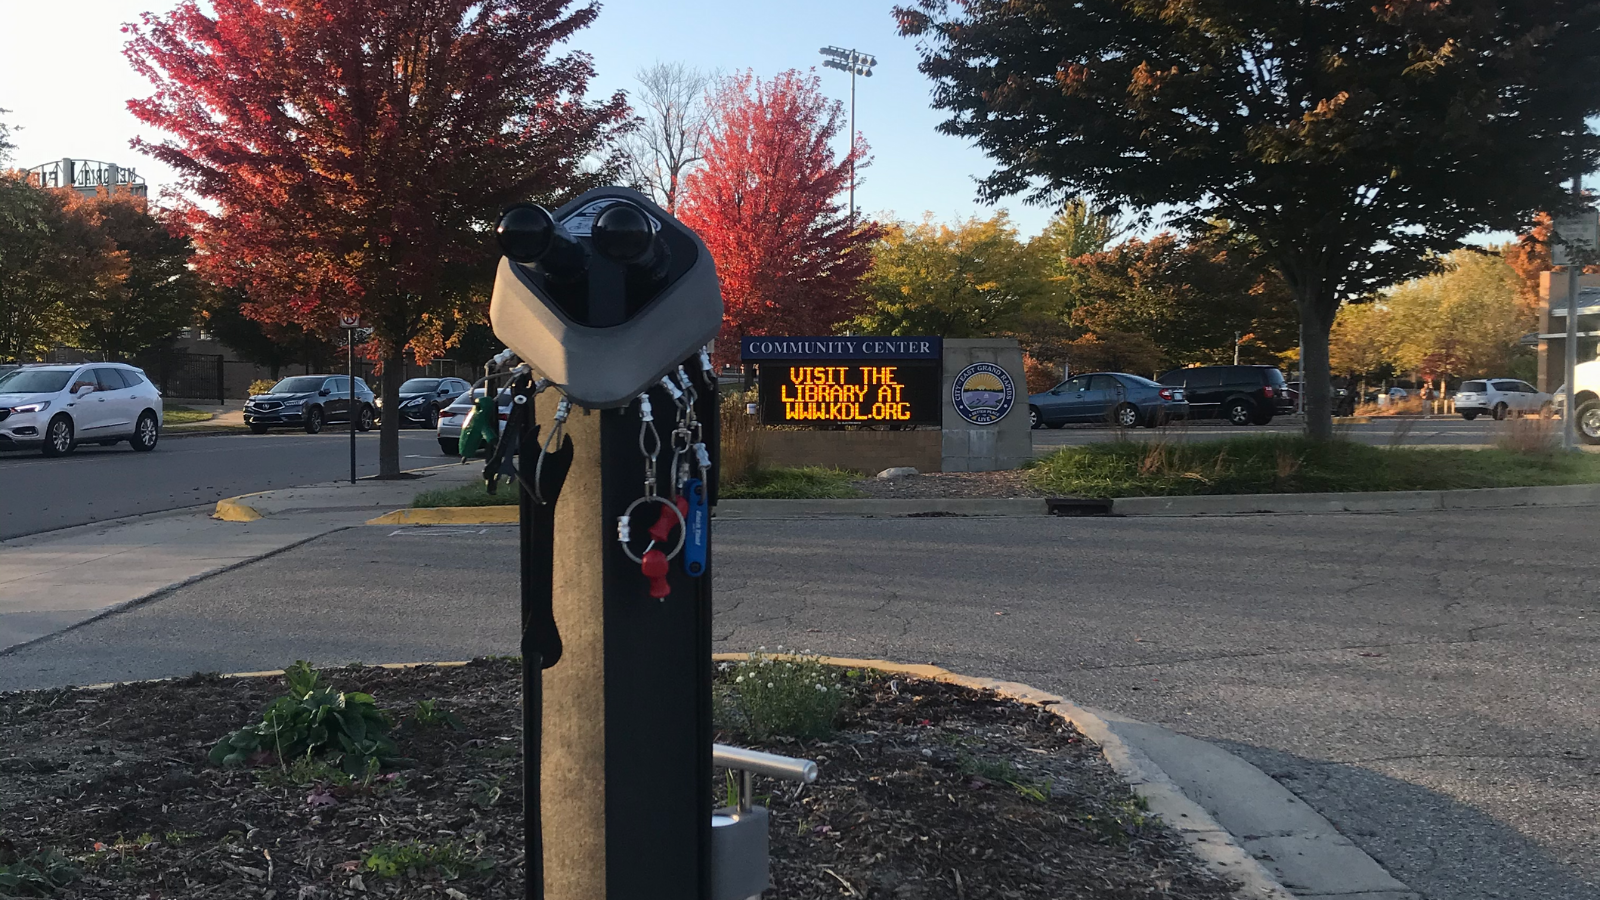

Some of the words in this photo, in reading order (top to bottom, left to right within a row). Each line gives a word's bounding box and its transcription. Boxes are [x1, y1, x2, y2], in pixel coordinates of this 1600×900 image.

[750, 341, 857, 354] COMMUNITY
[862, 341, 930, 353] CENTER
[790, 367, 849, 385] VISIT
[859, 367, 897, 385] THE
[960, 368, 975, 381] EAST
[978, 366, 1001, 375] GRAND
[1001, 375, 1012, 400] RAPIDS
[781, 385, 868, 402] LIBRARY
[878, 385, 904, 402] AT
[785, 402, 911, 420] WWW.KDL.ORG
